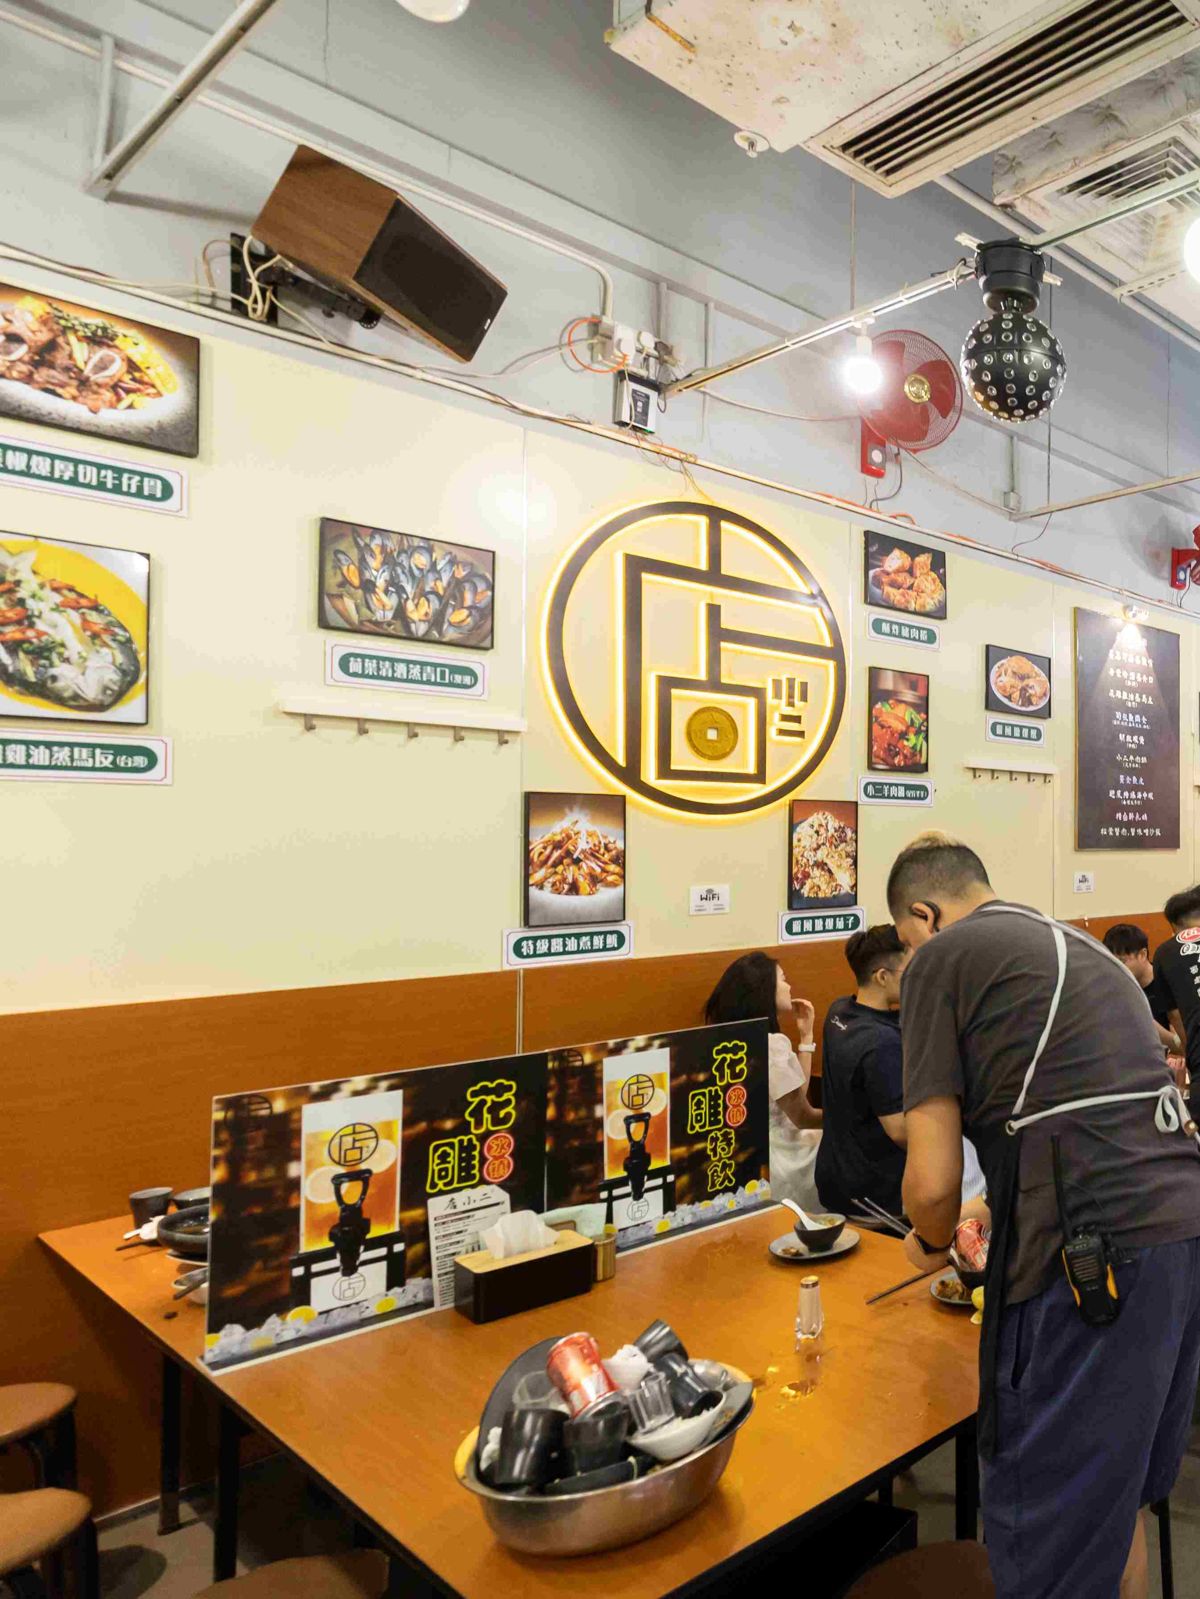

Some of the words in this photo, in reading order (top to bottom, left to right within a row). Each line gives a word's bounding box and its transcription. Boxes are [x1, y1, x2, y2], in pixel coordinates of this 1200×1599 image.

[0, 448, 163, 498] 椒爆厚切牛仔骨
